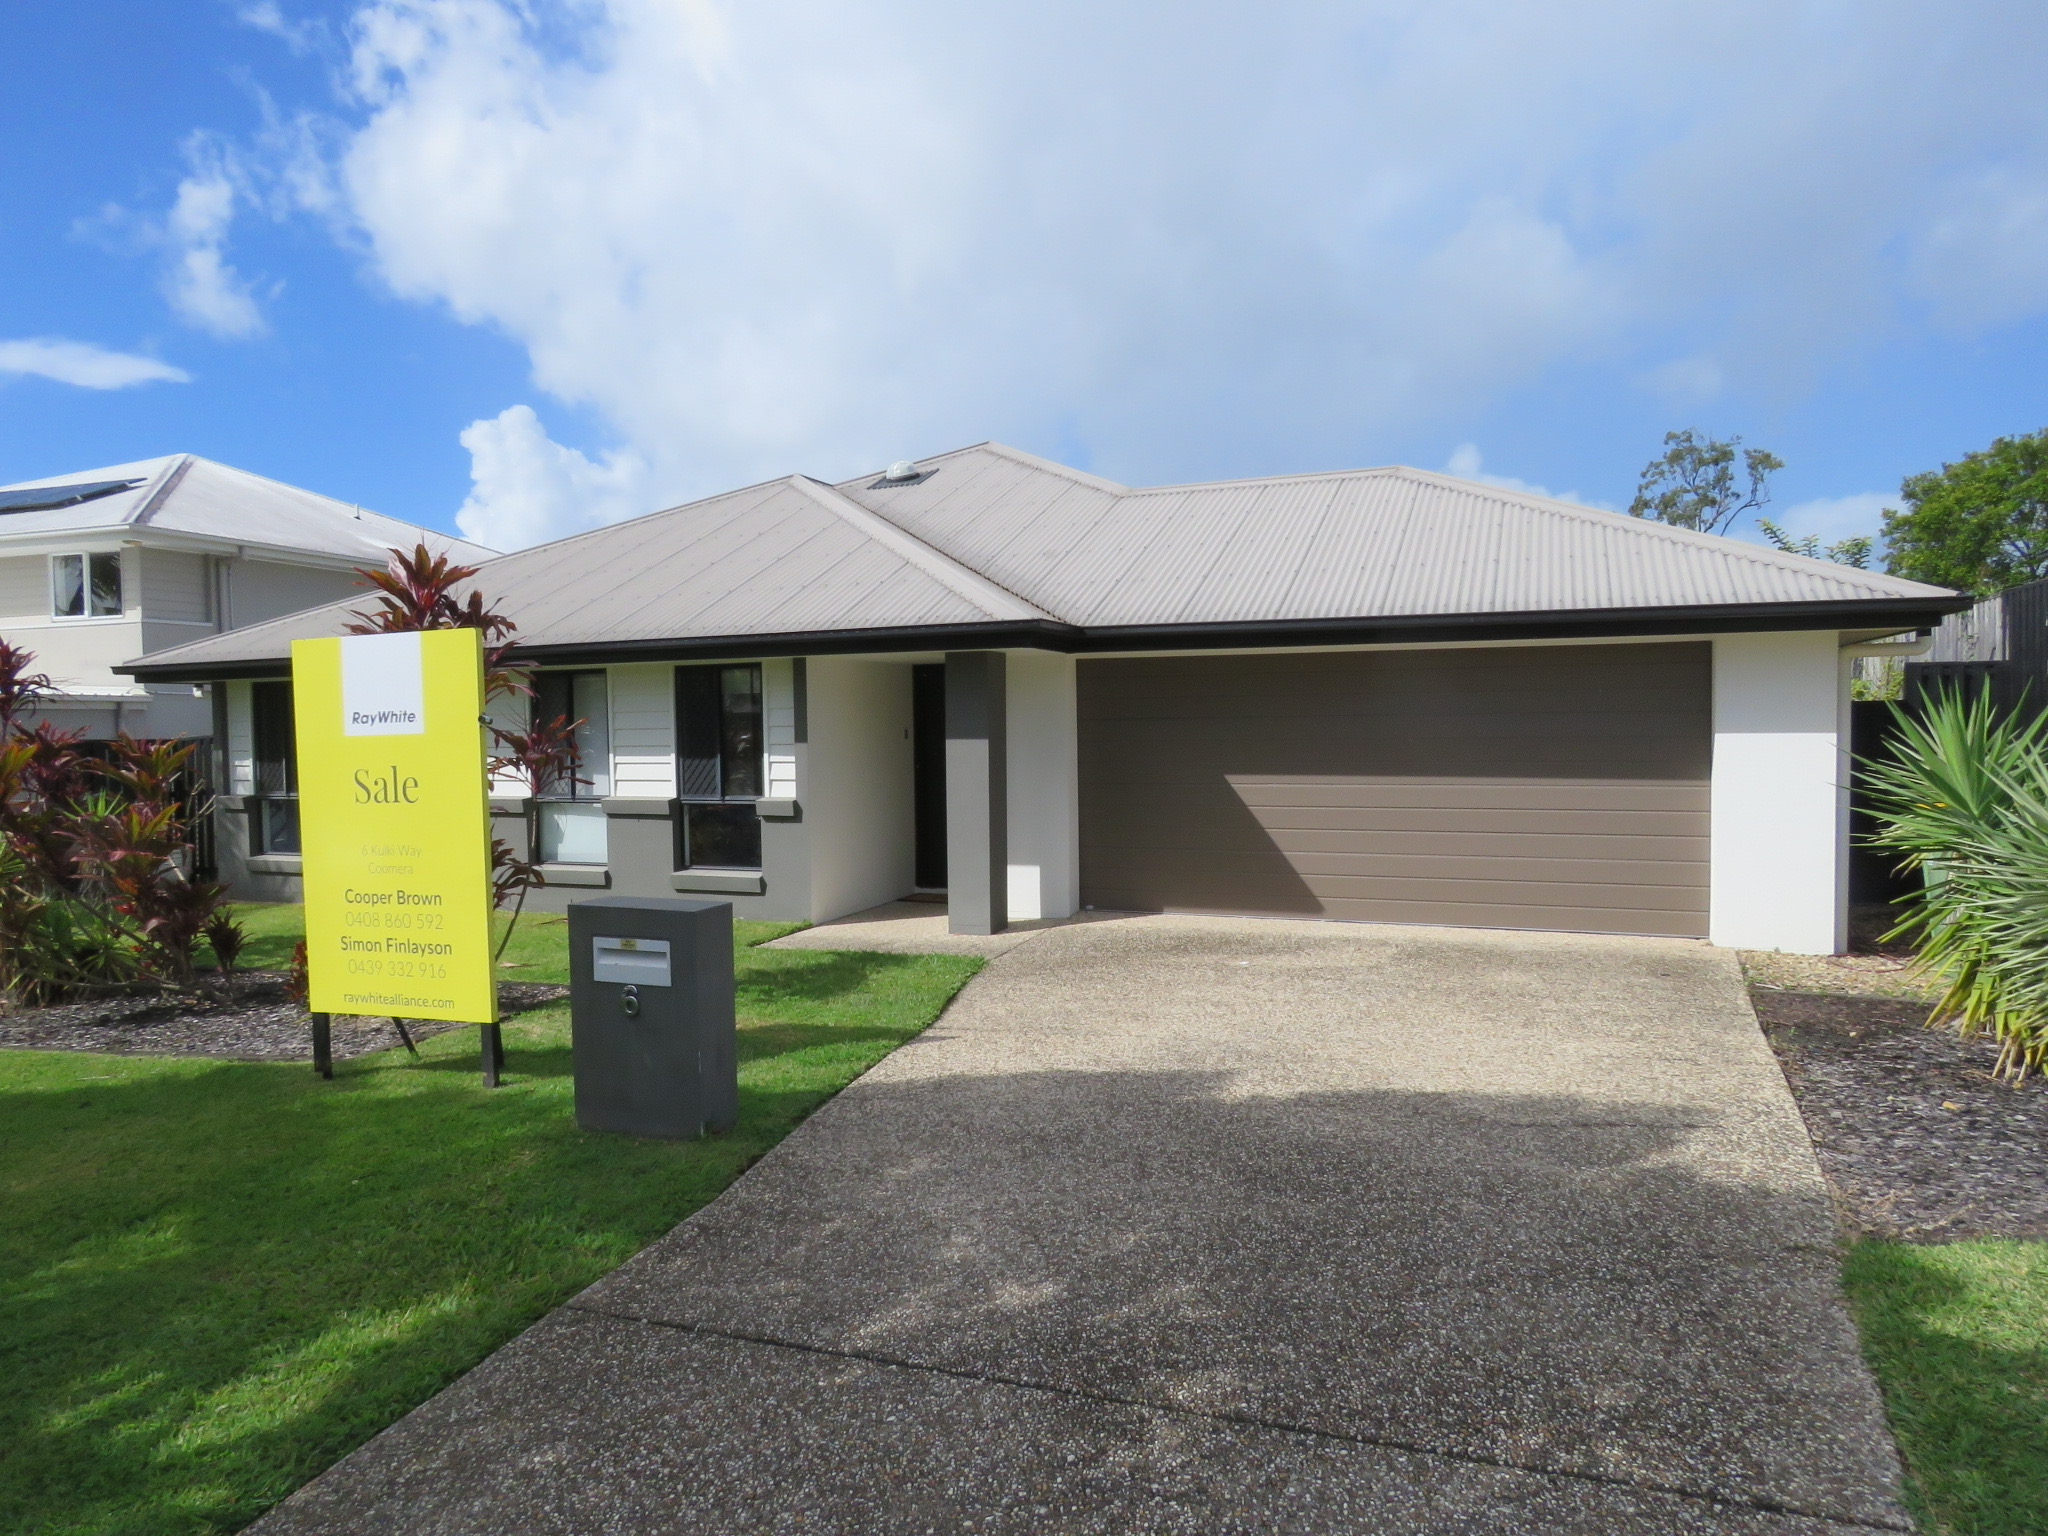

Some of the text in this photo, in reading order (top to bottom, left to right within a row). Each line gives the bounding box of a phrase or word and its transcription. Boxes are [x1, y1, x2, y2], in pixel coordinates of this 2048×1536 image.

[352, 710, 416, 726] RayWhite
[354, 765, 419, 804] Sale
[361, 845, 368, 856] 6
[398, 845, 422, 858] Way
[368, 862, 414, 875] Coomera
[345, 889, 442, 907] Cooper Brown
[346, 911, 443, 930] 0408 860 592
[341, 936, 453, 957] Simon Finlayson
[348, 959, 447, 979] 0439 332 916
[344, 993, 455, 1009] raywhitealliance.com
[621, 984, 638, 1016] 6
